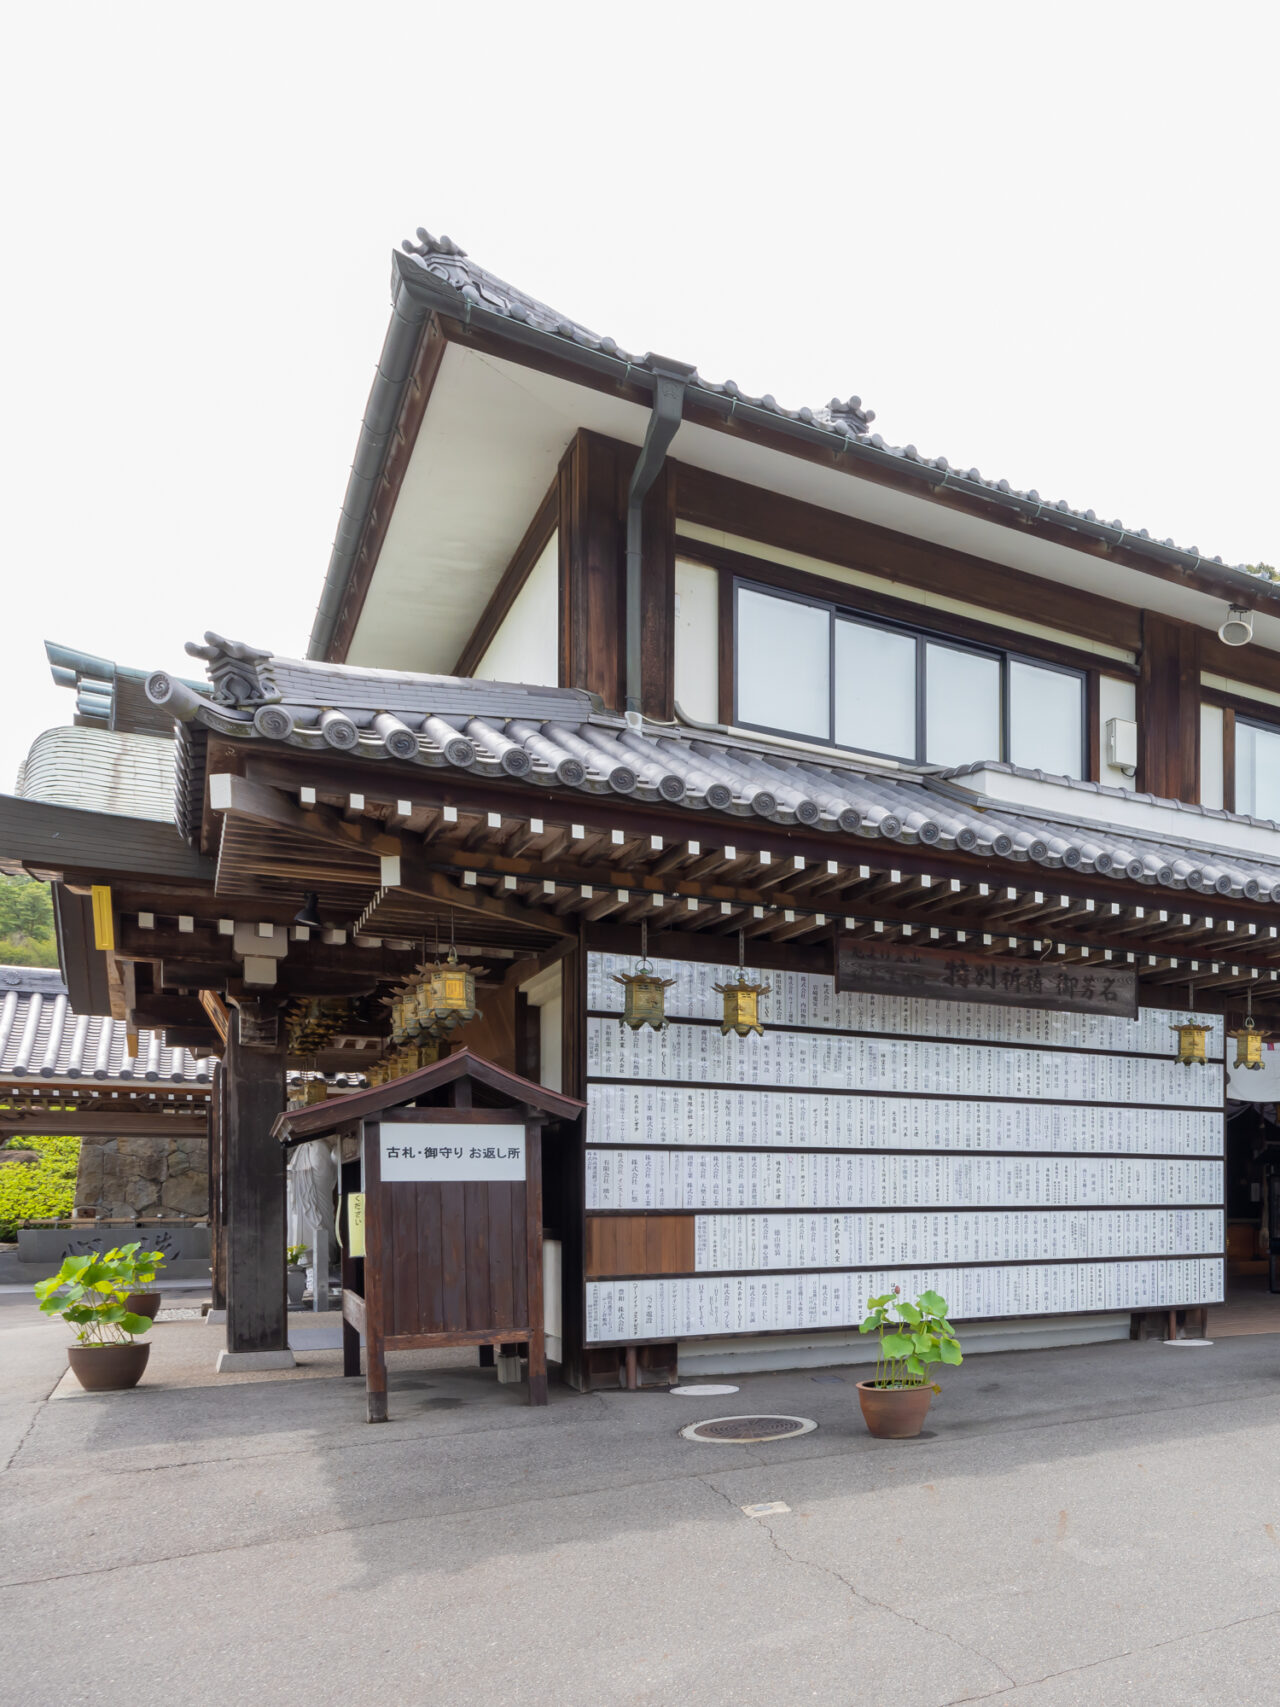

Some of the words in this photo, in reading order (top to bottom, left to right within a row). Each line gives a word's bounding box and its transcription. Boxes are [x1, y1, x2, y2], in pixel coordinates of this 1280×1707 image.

[386, 1146, 464, 1159] 古札・御守り
[469, 1147, 521, 1160] お返し所
